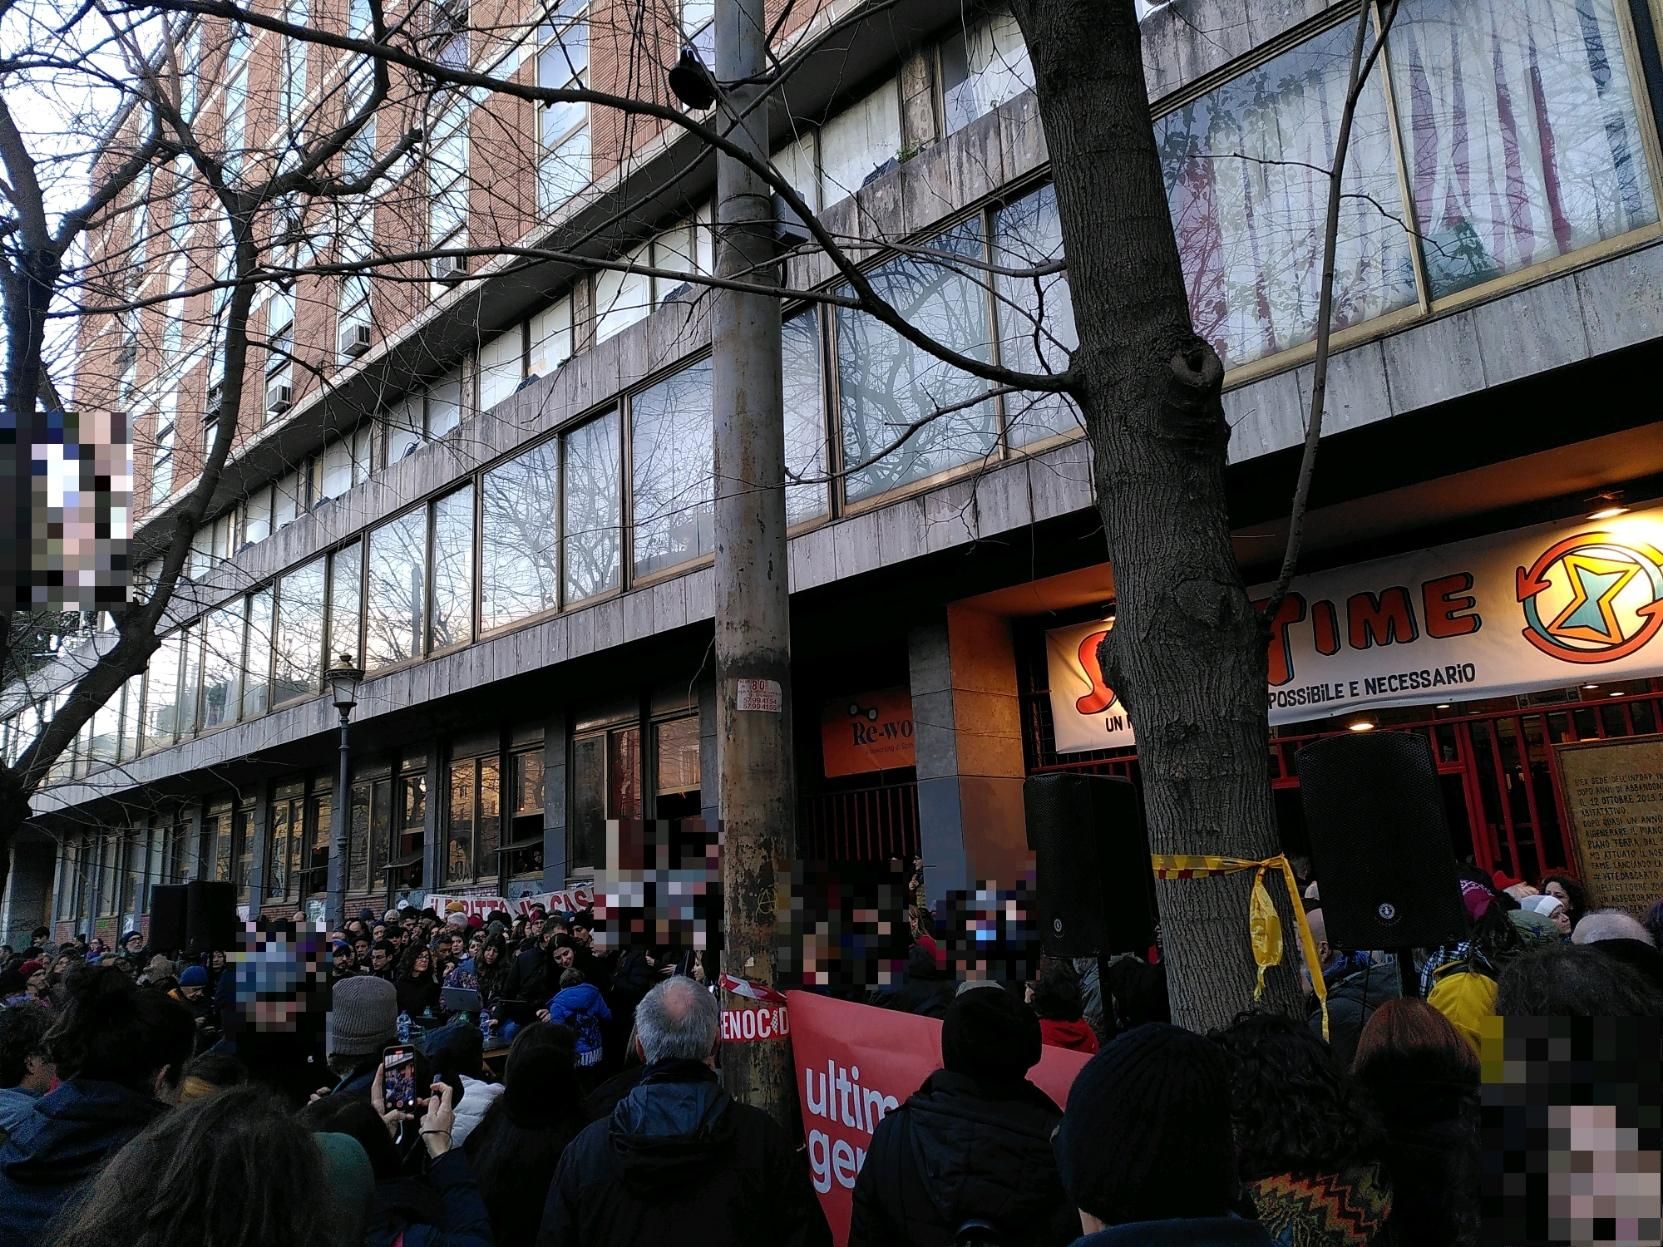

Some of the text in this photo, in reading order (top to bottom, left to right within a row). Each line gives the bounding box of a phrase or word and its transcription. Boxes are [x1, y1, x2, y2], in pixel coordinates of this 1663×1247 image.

[1251, 572, 1482, 687] TIME
[1350, 680, 1360, 698] E
[852, 719, 913, 746] Re-wo
[1105, 716, 1123, 732] UN
[1601, 794, 1634, 805] OTTOBRE
[1641, 814, 1663, 824] ANNO
[549, 888, 593, 913] CAS
